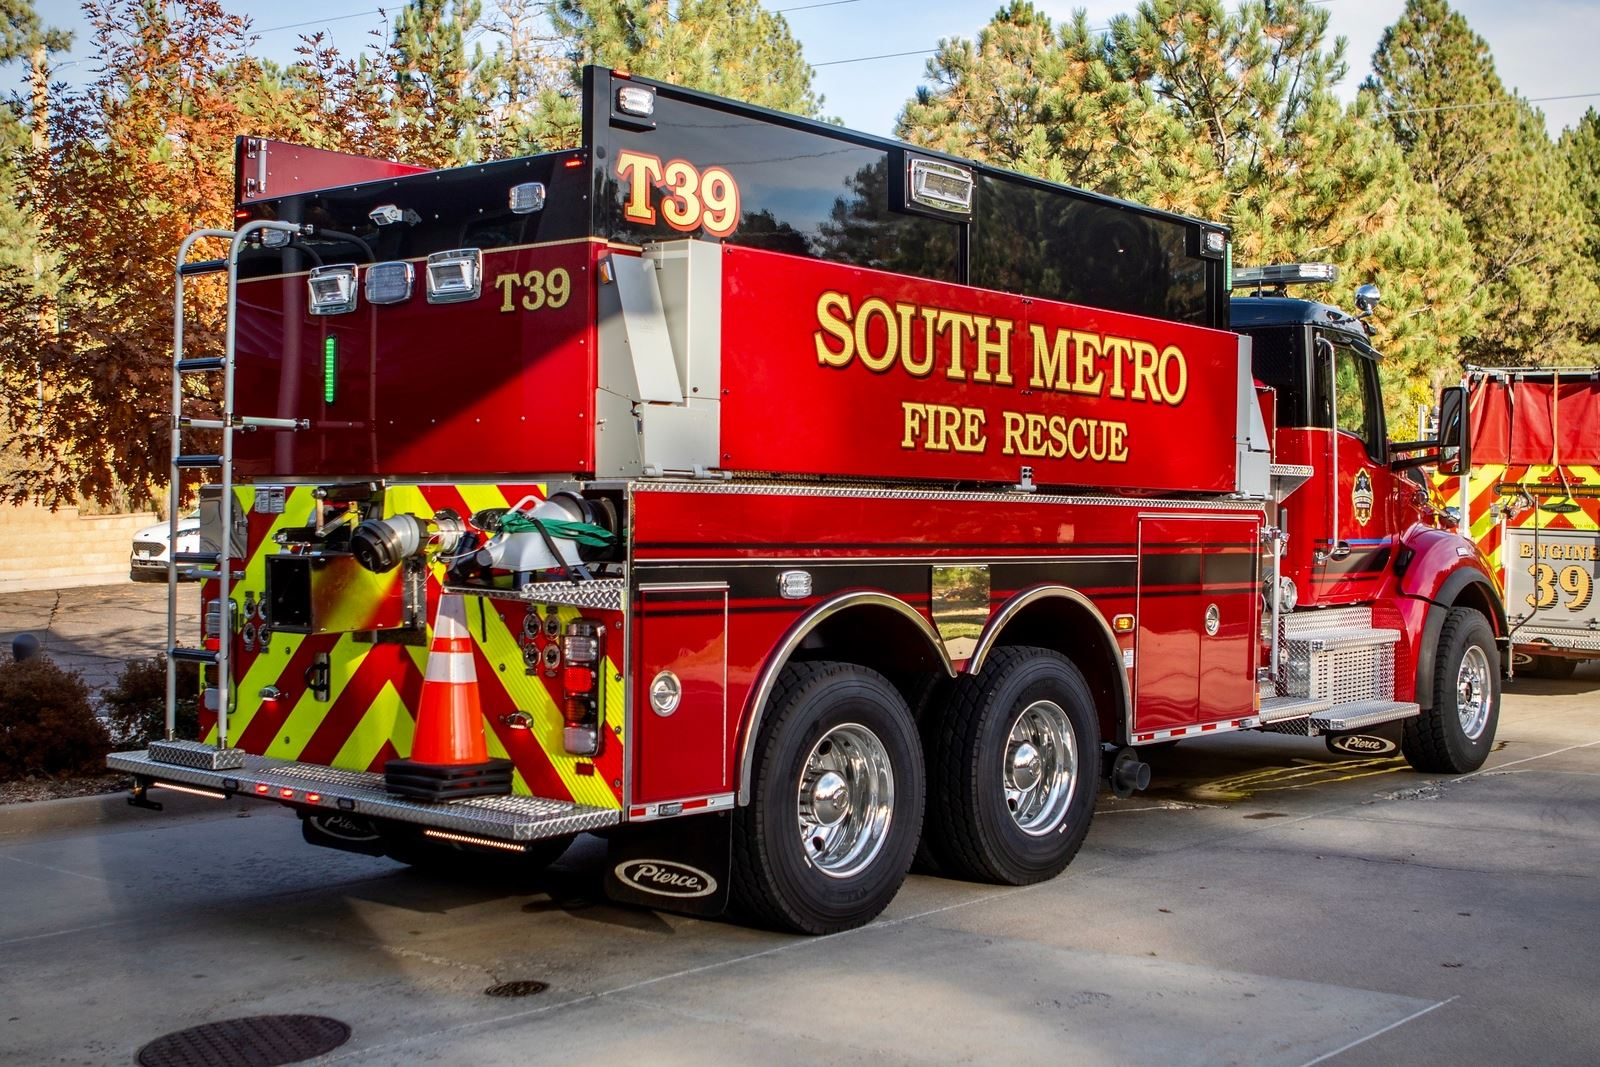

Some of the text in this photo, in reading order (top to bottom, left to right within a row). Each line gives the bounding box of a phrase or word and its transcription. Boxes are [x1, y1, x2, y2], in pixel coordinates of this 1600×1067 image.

[616, 149, 740, 238] T39
[495, 267, 571, 312] T39
[814, 290, 1189, 406] SOUTH METRO
[901, 401, 1129, 463] FIRE RESCUE
[1520, 542, 1600, 560] ENGINE
[1525, 563, 1593, 612] 39
[1344, 736, 1381, 750] Pierce
[633, 863, 698, 889] Pierce
